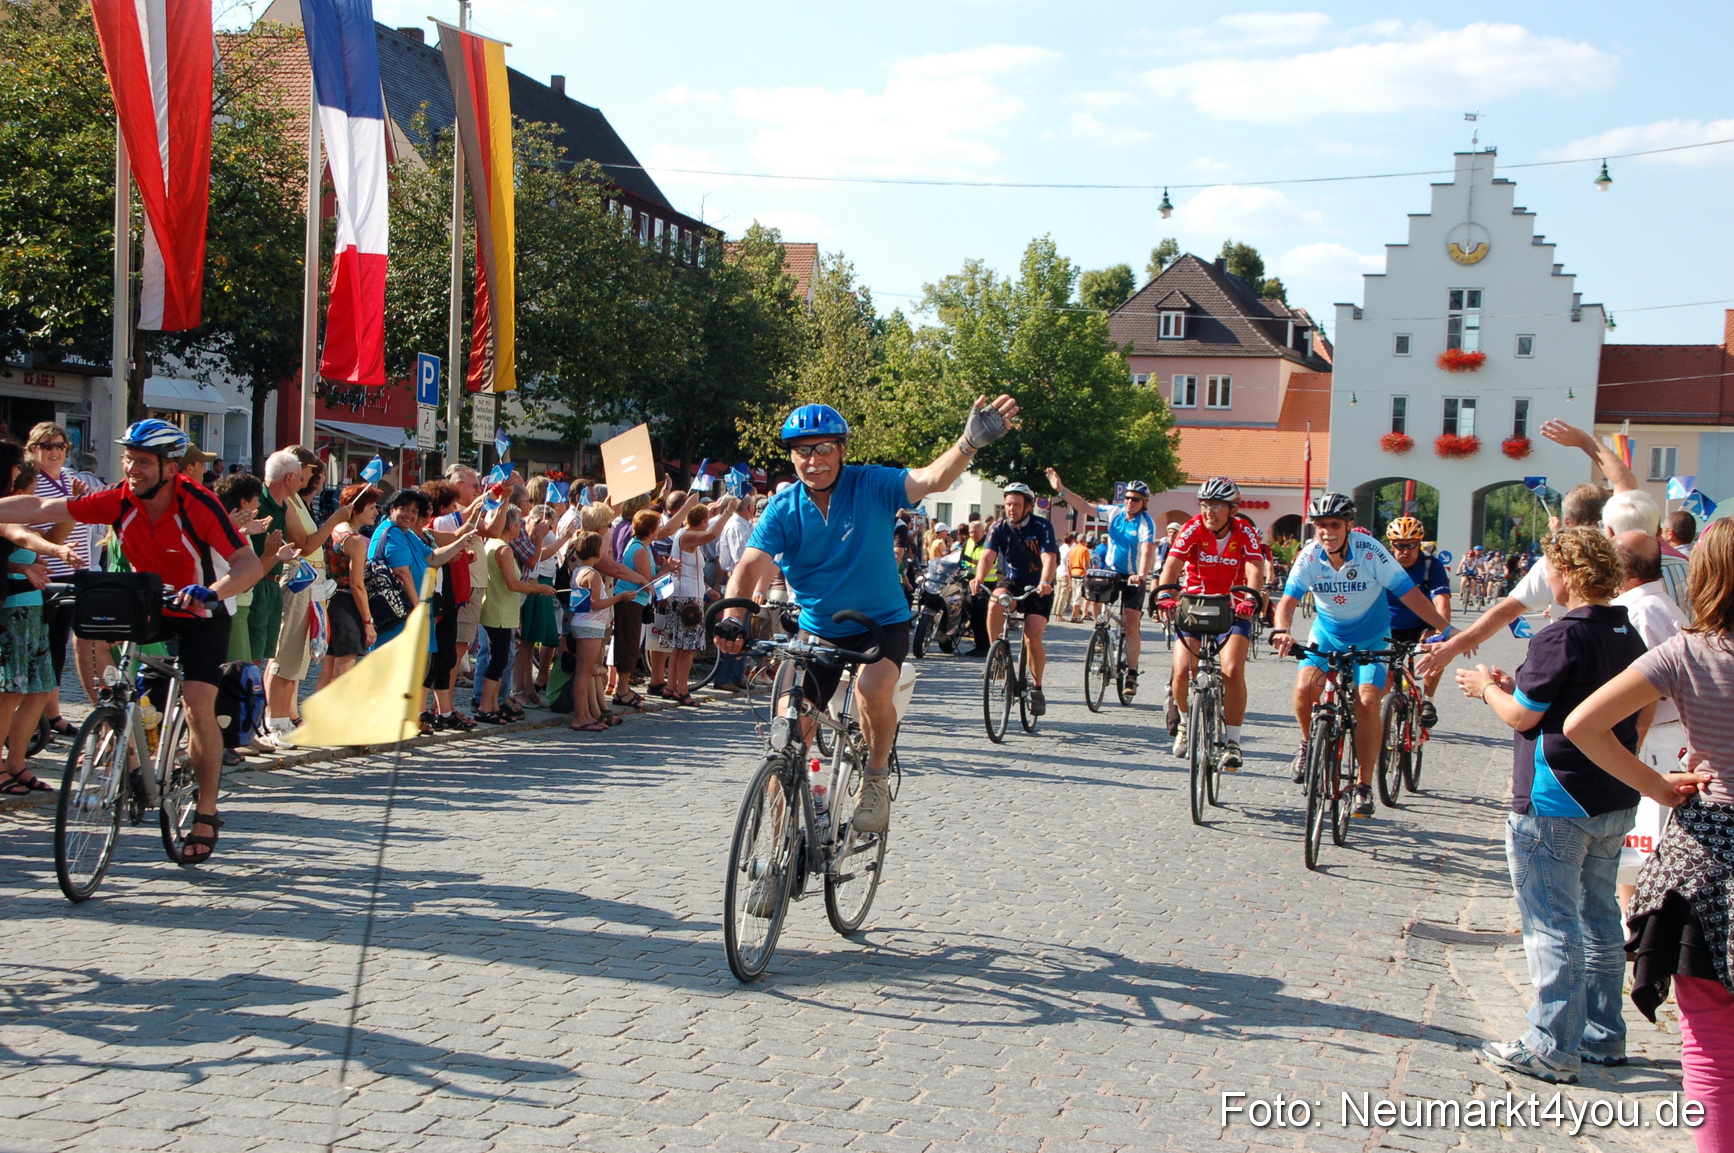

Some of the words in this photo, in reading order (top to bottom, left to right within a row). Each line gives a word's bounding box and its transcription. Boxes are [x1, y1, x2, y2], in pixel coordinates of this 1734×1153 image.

[24, 373, 34, 385] ICE
[35, 374, 50, 387] AGE
[50, 375, 55, 388] 3
[422, 361, 434, 397] P
[1117, 485, 1124, 499] P
[1355, 541, 1389, 564] GEROLSTEINER
